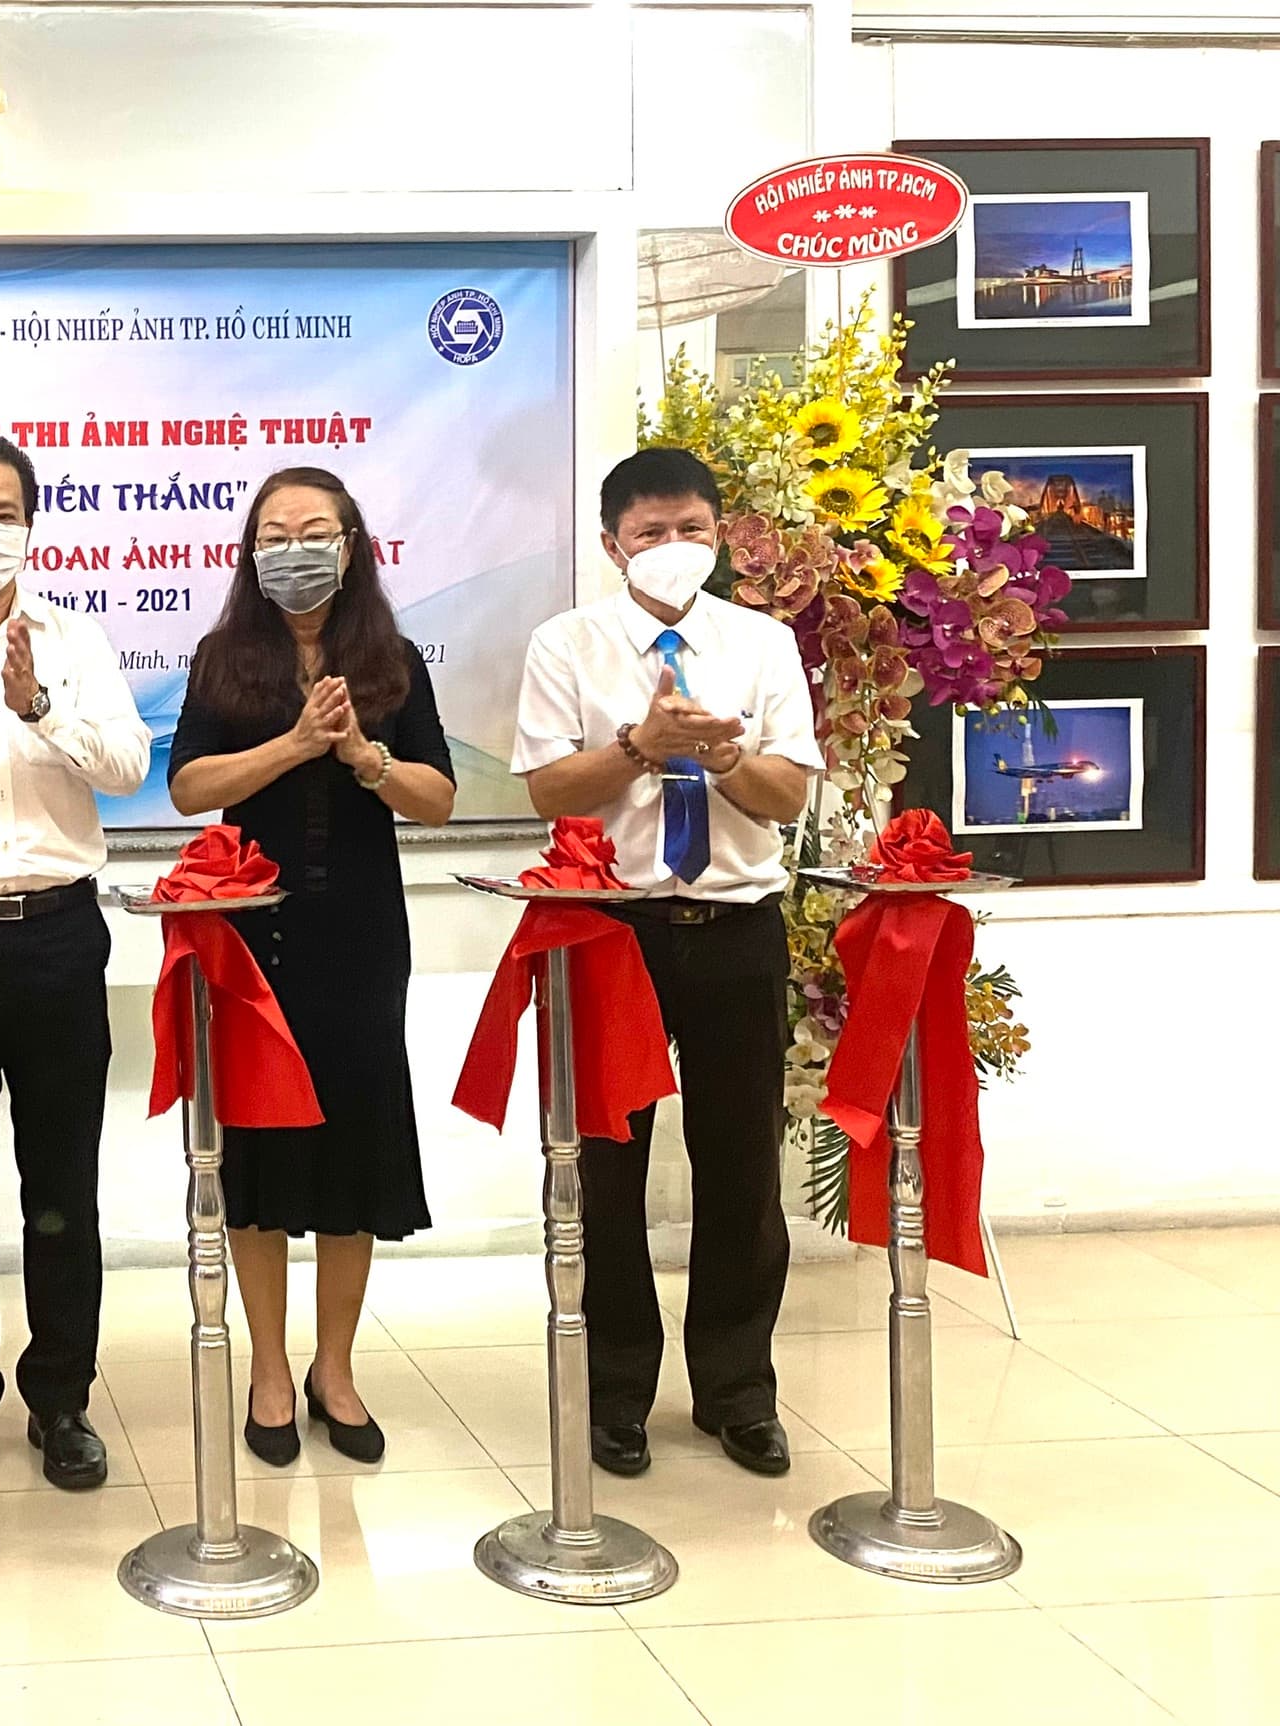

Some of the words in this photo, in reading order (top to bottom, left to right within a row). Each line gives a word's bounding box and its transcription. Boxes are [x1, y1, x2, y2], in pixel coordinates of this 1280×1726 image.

[754, 183, 785, 215] HỘI
[787, 163, 836, 201] NHIẾP
[839, 164, 874, 190] ẢNH
[877, 169, 937, 201] TP.HCM
[777, 231, 843, 259] CHÚC
[847, 221, 919, 257] MỪNG
[12, 310, 50, 348] HỘI
[57, 308, 123, 341] NHIẾP
[129, 307, 174, 340] ẢNH
[179, 317, 209, 340] TP.
[215, 305, 245, 340] HỒ
[252, 309, 289, 339] CHÍ
[296, 316, 352, 339] MINH
[453, 354, 478, 363] HOPA
[12, 422, 70, 448] THI
[81, 412, 148, 447] ẢNH
[161, 413, 248, 451] NGHỆ
[260, 411, 371, 450] THUẬT
[123, 537, 191, 571] ẢNH
[38, 591, 78, 611] hứ
[85, 590, 106, 613] XI
[136, 588, 191, 612] 2021
[119, 649, 169, 671] Minh,
